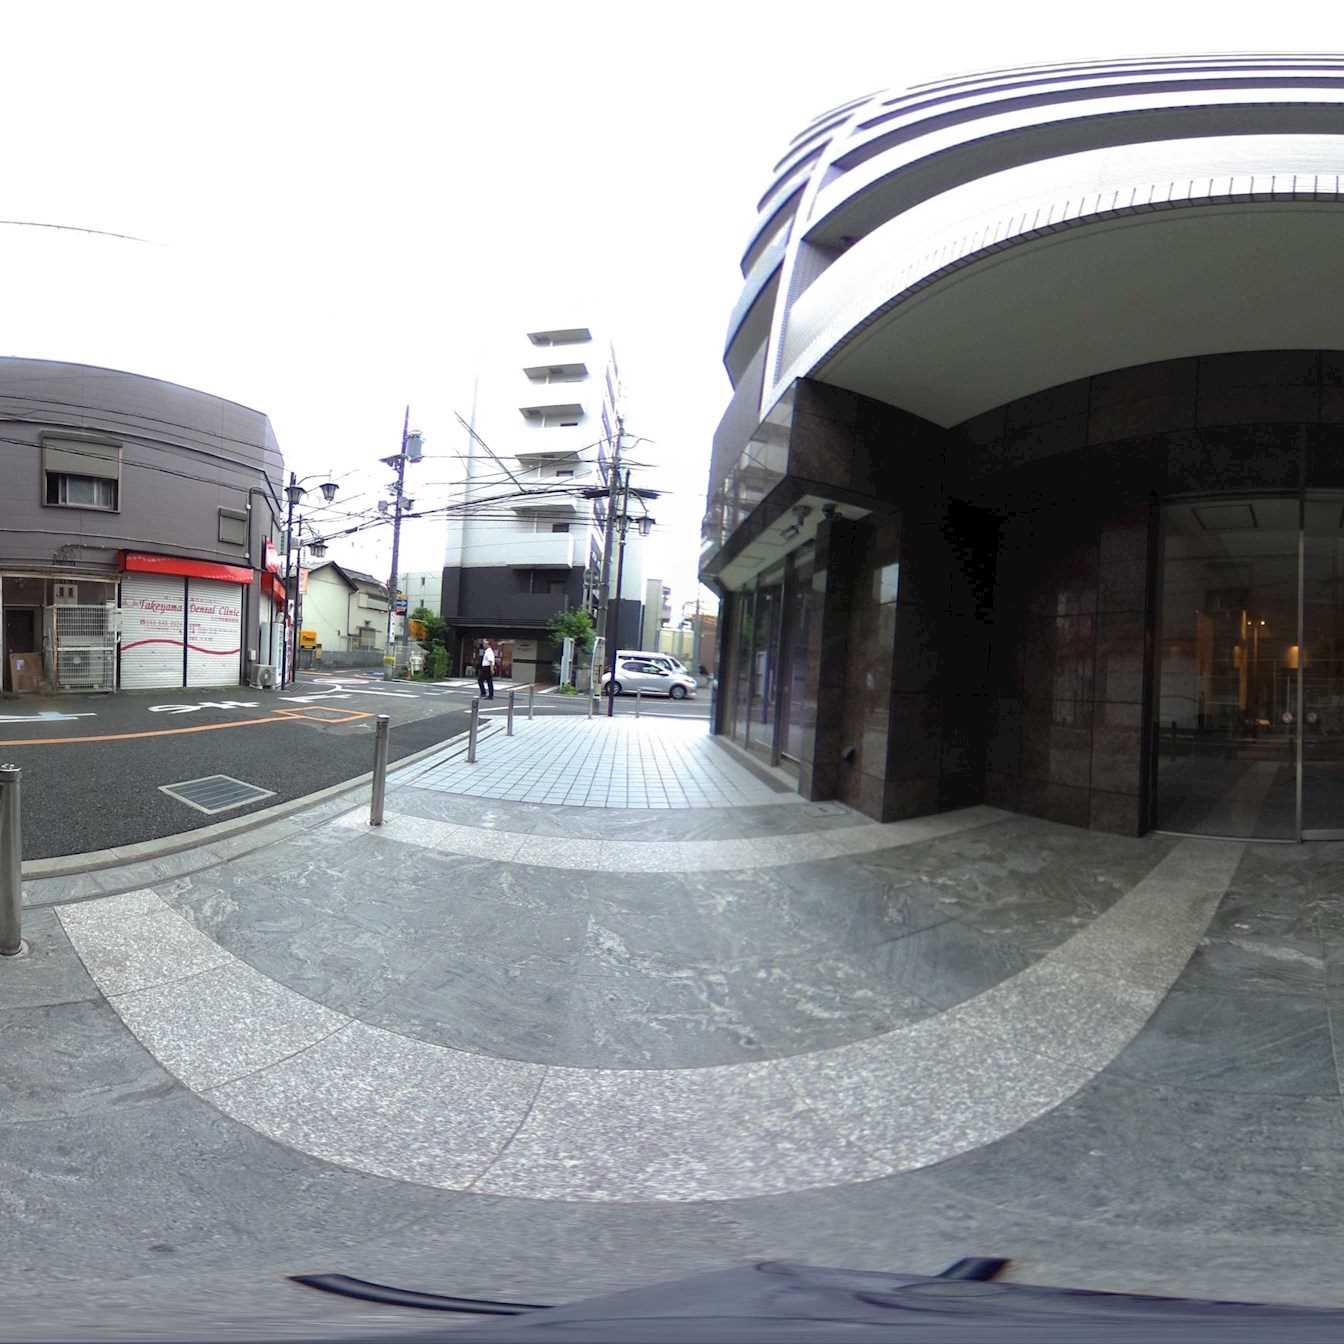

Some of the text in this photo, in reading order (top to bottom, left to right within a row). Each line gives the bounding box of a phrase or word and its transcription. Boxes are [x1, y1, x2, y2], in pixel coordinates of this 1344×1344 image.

[140, 599, 183, 614] Takeyama
[190, 604, 215, 616] Dental
[219, 606, 240, 617] Clinic
